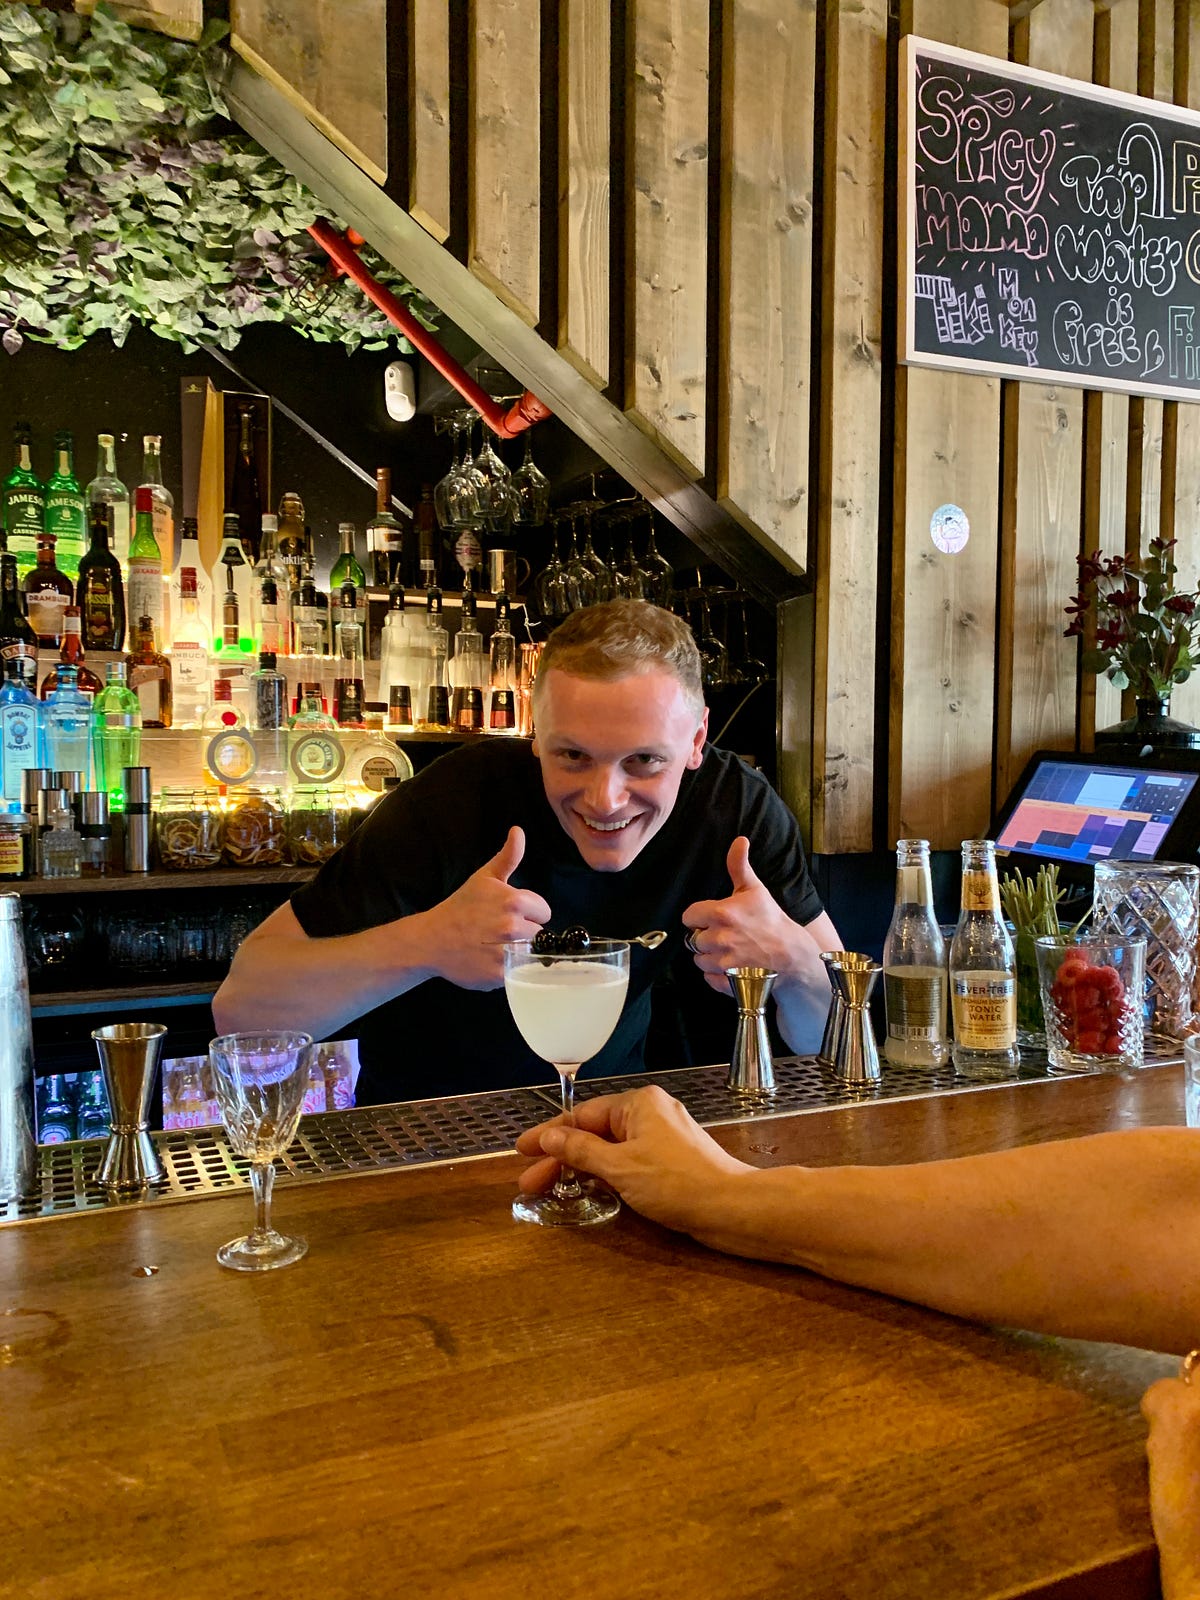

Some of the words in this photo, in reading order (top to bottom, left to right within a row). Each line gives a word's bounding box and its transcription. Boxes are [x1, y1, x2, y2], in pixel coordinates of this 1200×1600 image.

[1169, 306, 1200, 380] Fi
[8, 494, 44, 505] JAMESO
[957, 984, 1013, 994] FEVER-TREE
[970, 1005, 1000, 1013] TONIC
[969, 1013, 1001, 1021] WATER
